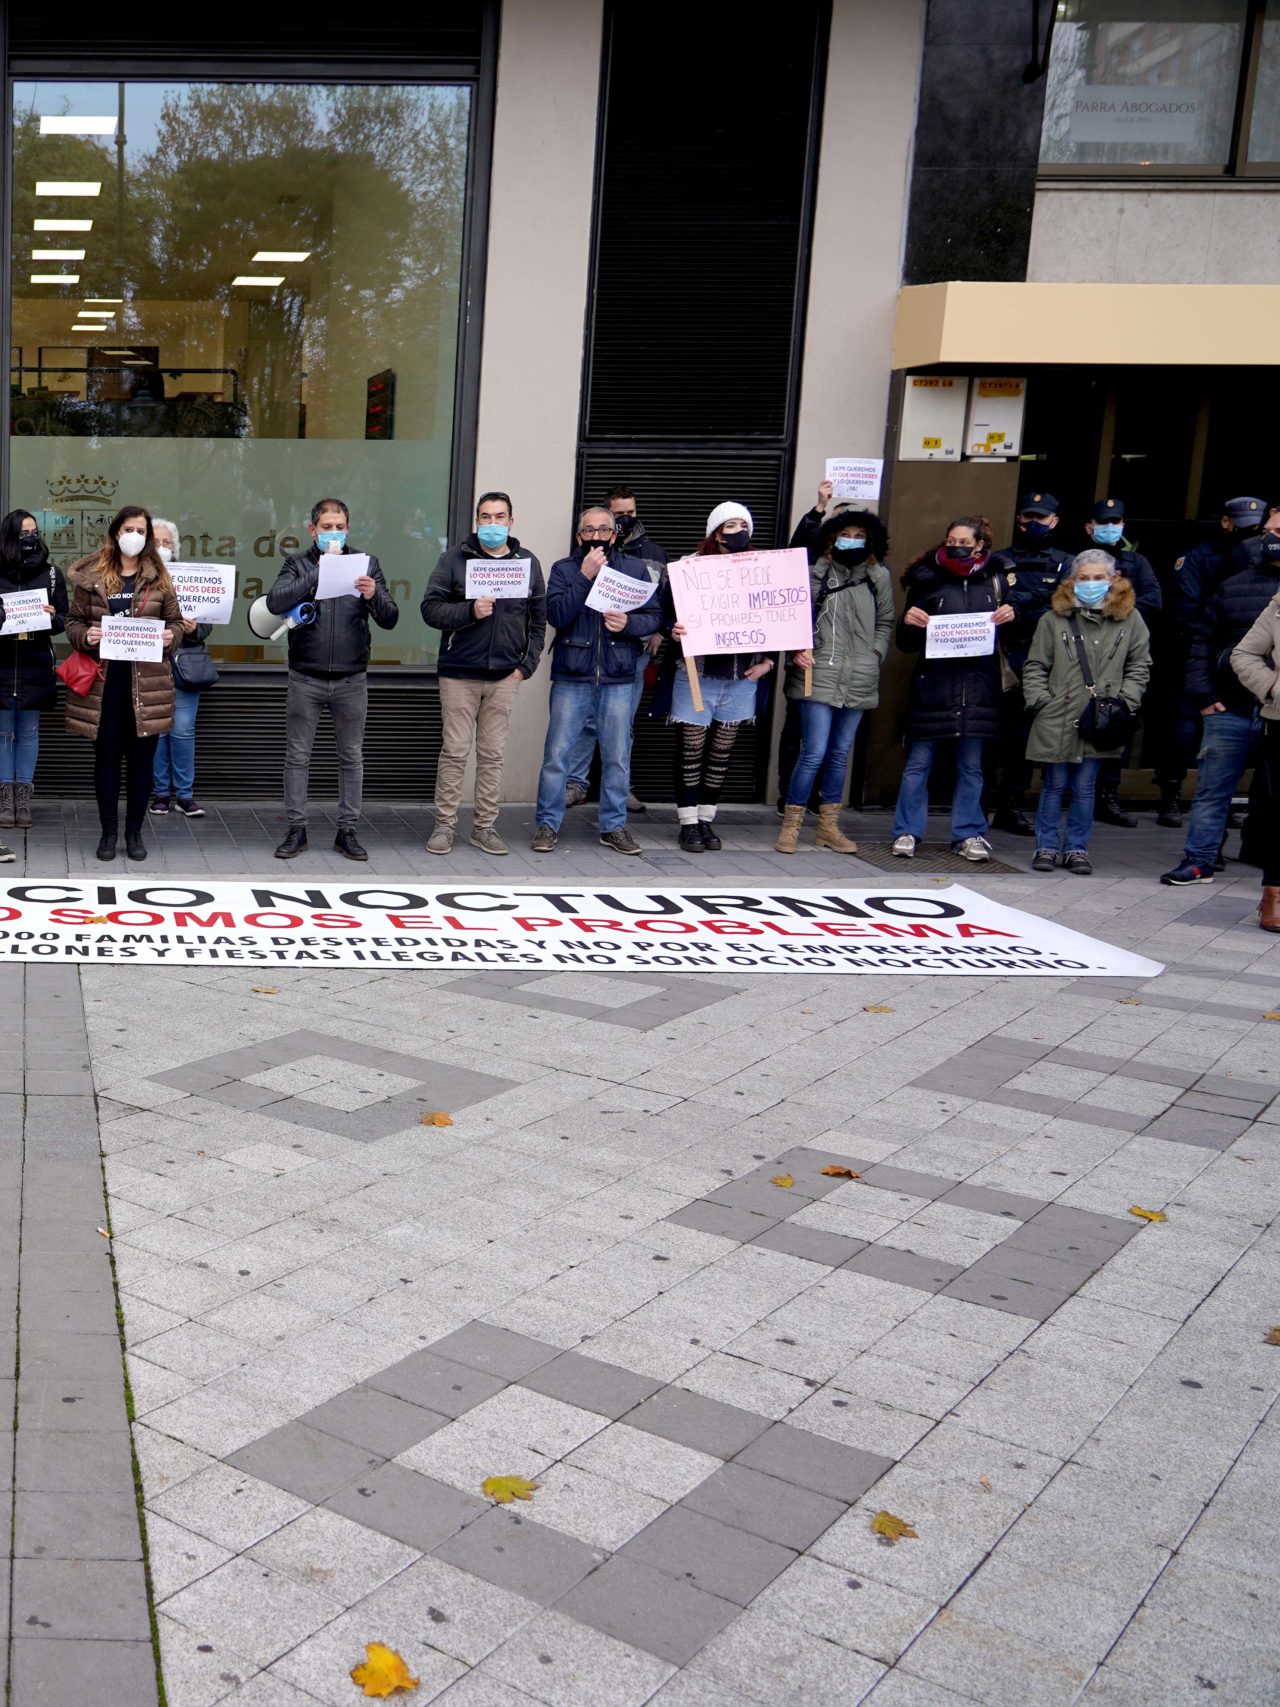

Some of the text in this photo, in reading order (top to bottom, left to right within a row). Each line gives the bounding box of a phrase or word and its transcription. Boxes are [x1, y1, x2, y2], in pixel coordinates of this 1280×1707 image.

[1075, 101, 1195, 113] PARRA ABOGADOS
[179, 529, 300, 558] nta de
[178, 576, 222, 584] QUEREMOS
[603, 576, 616, 585] SEPE
[616, 583, 647, 594] QUEREMOS
[682, 566, 772, 591] NO SE PUEDE
[183, 585, 200, 593] NOS
[201, 586, 226, 594] DEBES
[605, 585, 617, 593] QUE
[617, 590, 630, 598] NOS
[700, 586, 808, 610] EXIGIR IMPUESTOS
[610, 596, 641, 605] QUEREMOS
[687, 608, 797, 628] SI PROHIBES TENER
[123, 625, 157, 633] QUEREMOS
[715, 630, 766, 646] INGRESOS
[122, 639, 155, 647] QUEREMOS
[251, 889, 965, 919] NOCTURNO
[48, 908, 363, 929] SOMOS
[385, 914, 498, 931] EL
[511, 916, 1023, 938] PROBLEMA
[74, 933, 259, 946] FAMILIAS
[270, 936, 519, 950] DESPEDIDAS
[525, 939, 547, 950] Y
[560, 939, 622, 950] NO
[632, 941, 722, 952] POR
[726, 943, 775, 953] EL
[779, 944, 1059, 956] EMPRESARIO.
[147, 947, 172, 958] Y
[185, 948, 342, 961] FIESTAS
[353, 950, 543, 963] ILEGALES
[552, 953, 617, 965] NO
[626, 954, 719, 966] SON
[726, 955, 837, 967] OCIO
[844, 957, 1107, 970] NOCTURNO.
